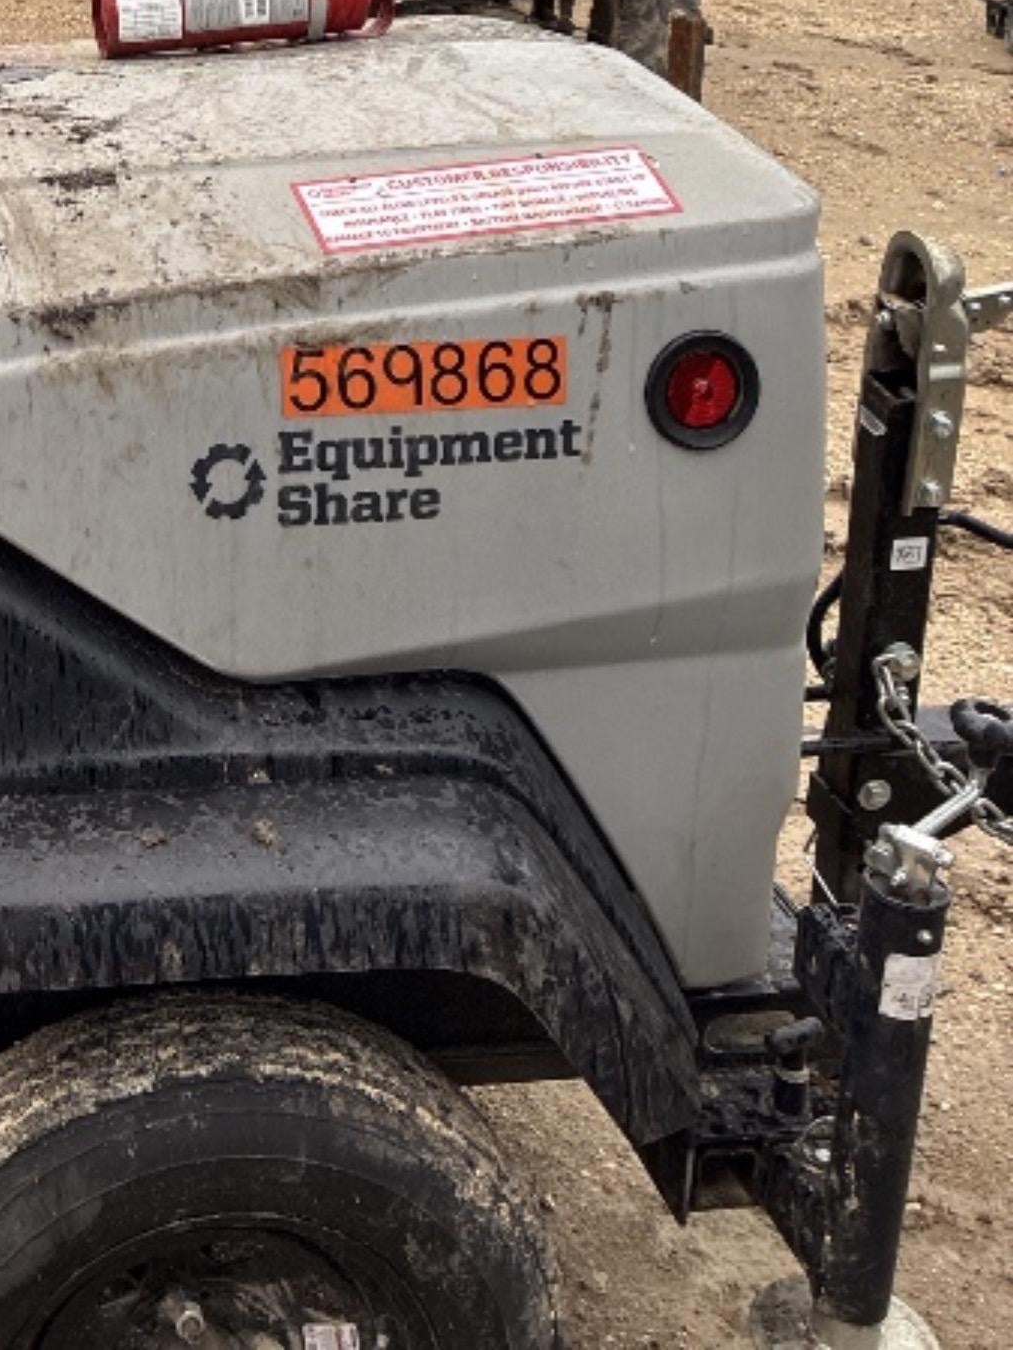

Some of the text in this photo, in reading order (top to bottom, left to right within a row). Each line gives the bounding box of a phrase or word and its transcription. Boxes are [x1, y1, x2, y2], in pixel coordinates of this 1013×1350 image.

[289, 338, 562, 413] 569868
[277, 418, 582, 481] Equipment
[276, 482, 441, 528] Share
